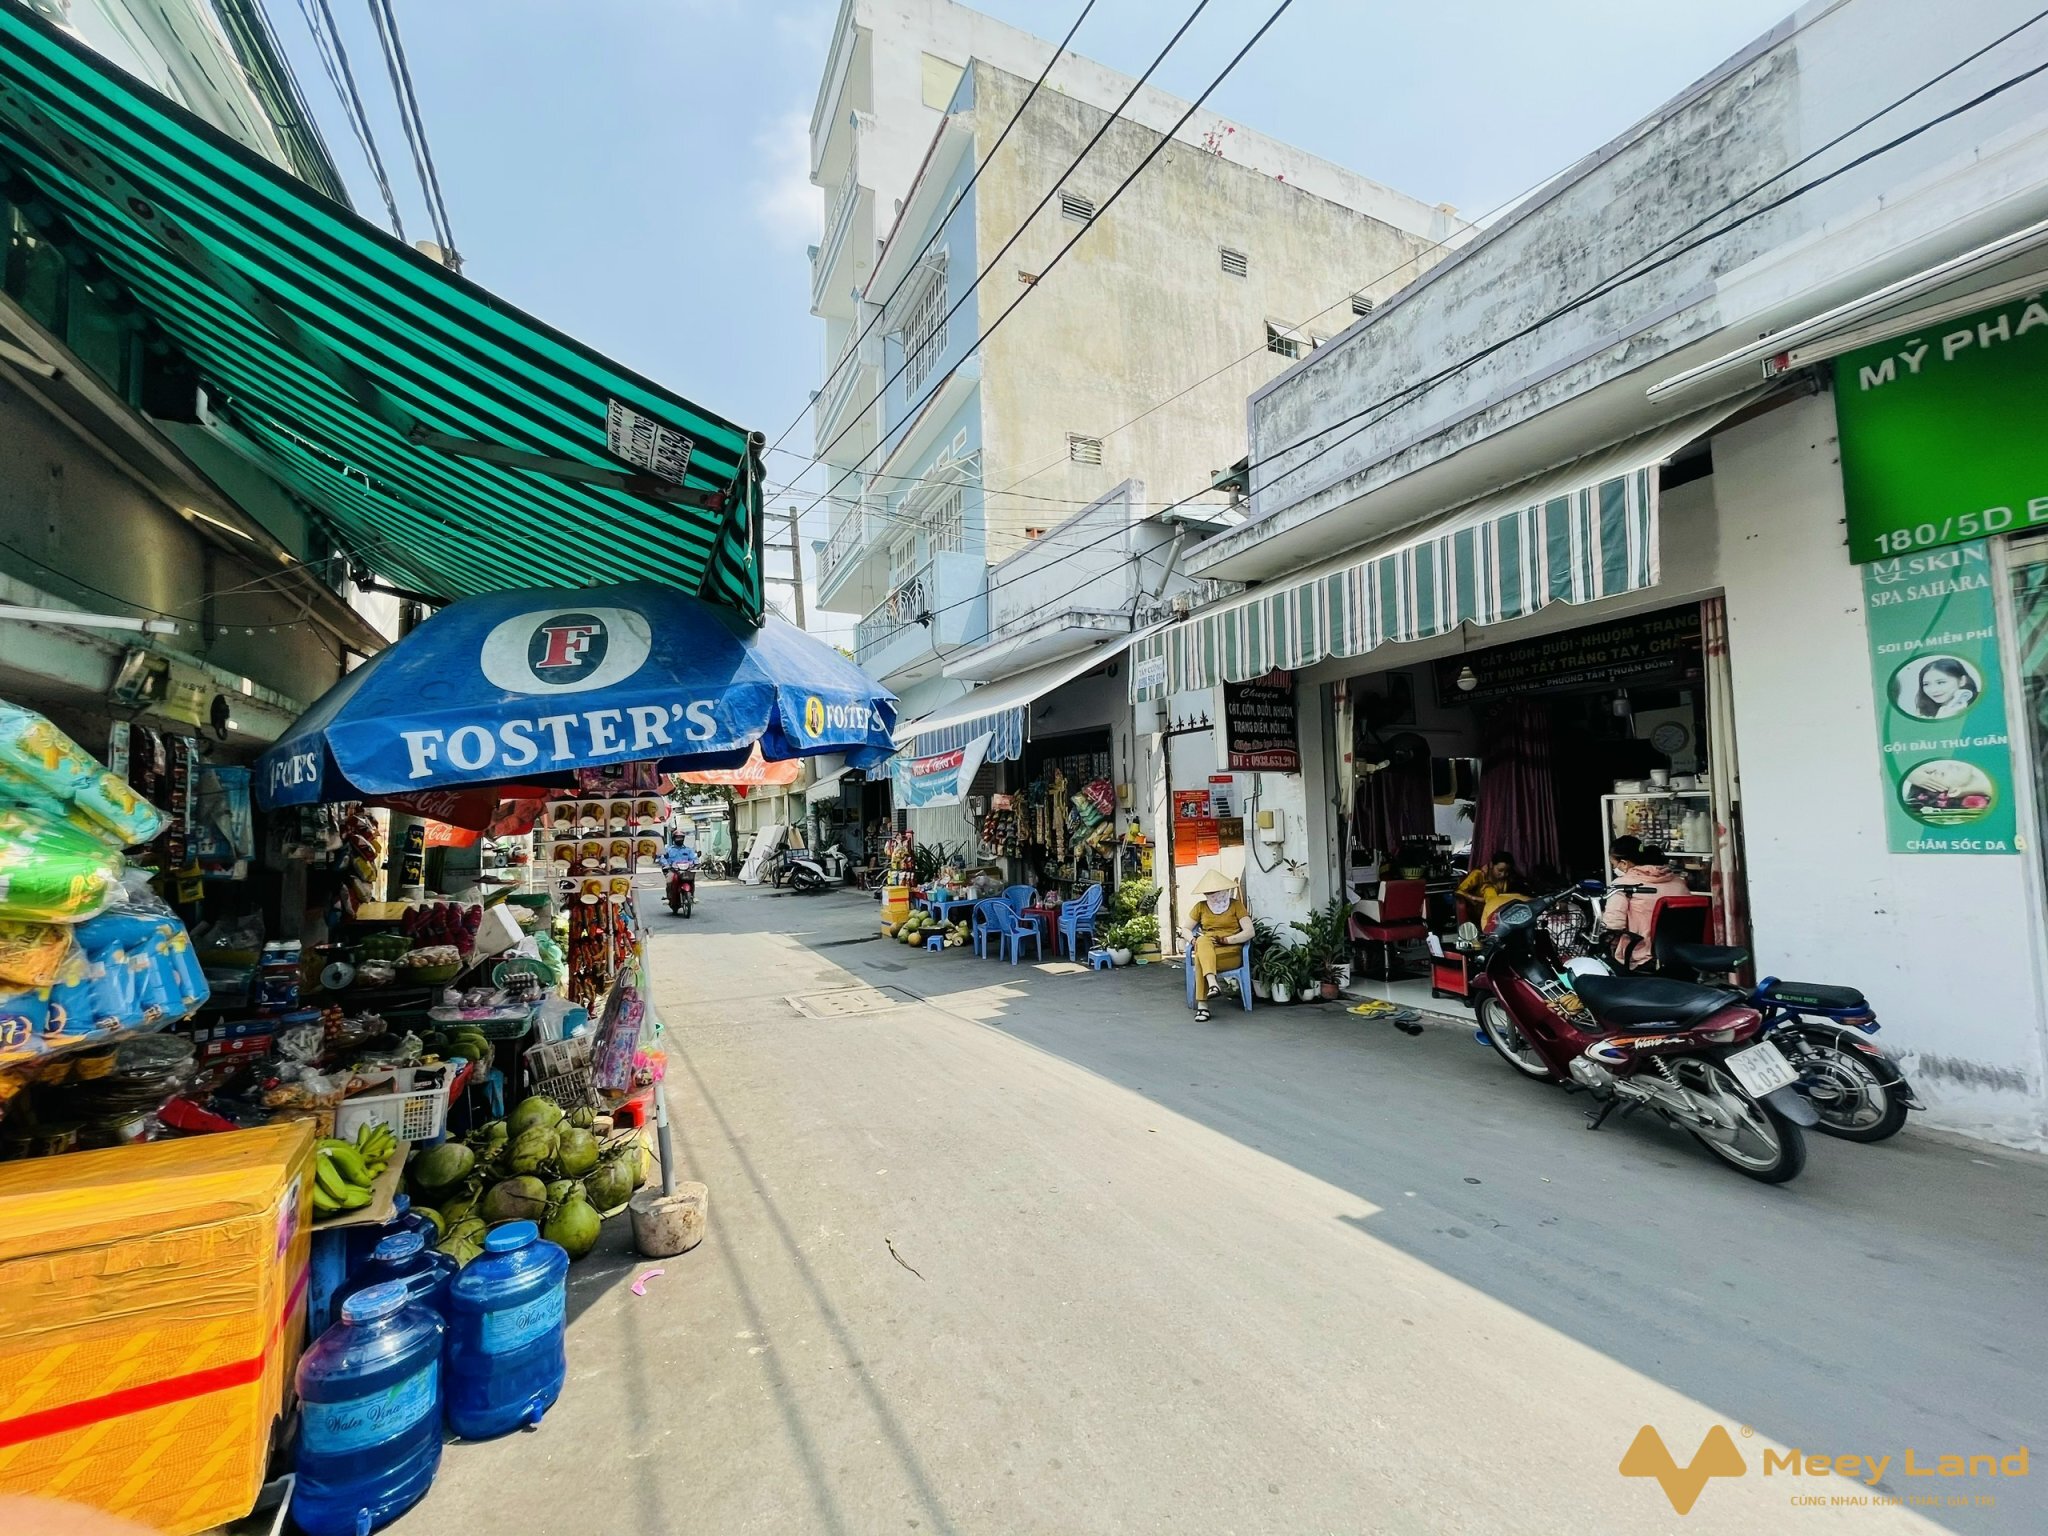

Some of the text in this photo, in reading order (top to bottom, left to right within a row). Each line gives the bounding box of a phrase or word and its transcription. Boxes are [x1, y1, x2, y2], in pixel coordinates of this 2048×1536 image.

[1859, 338, 1929, 391] MỸ
[1875, 506, 2012, 554] 180/5D
[1909, 544, 1985, 575] SKIN
[1871, 573, 1990, 608] SPA SAHARA
[1877, 641, 1901, 654] SOI
[1904, 638, 1923, 651] DA
[1966, 625, 1994, 641] PHÍ
[400, 699, 719, 780] FOSTER'S
[1233, 721, 1253, 733] TRANG
[1883, 742, 1907, 755] GỘI
[1940, 736, 1971, 749] THƯ
[1906, 838, 2007, 850] CHĂM SÓC DA
